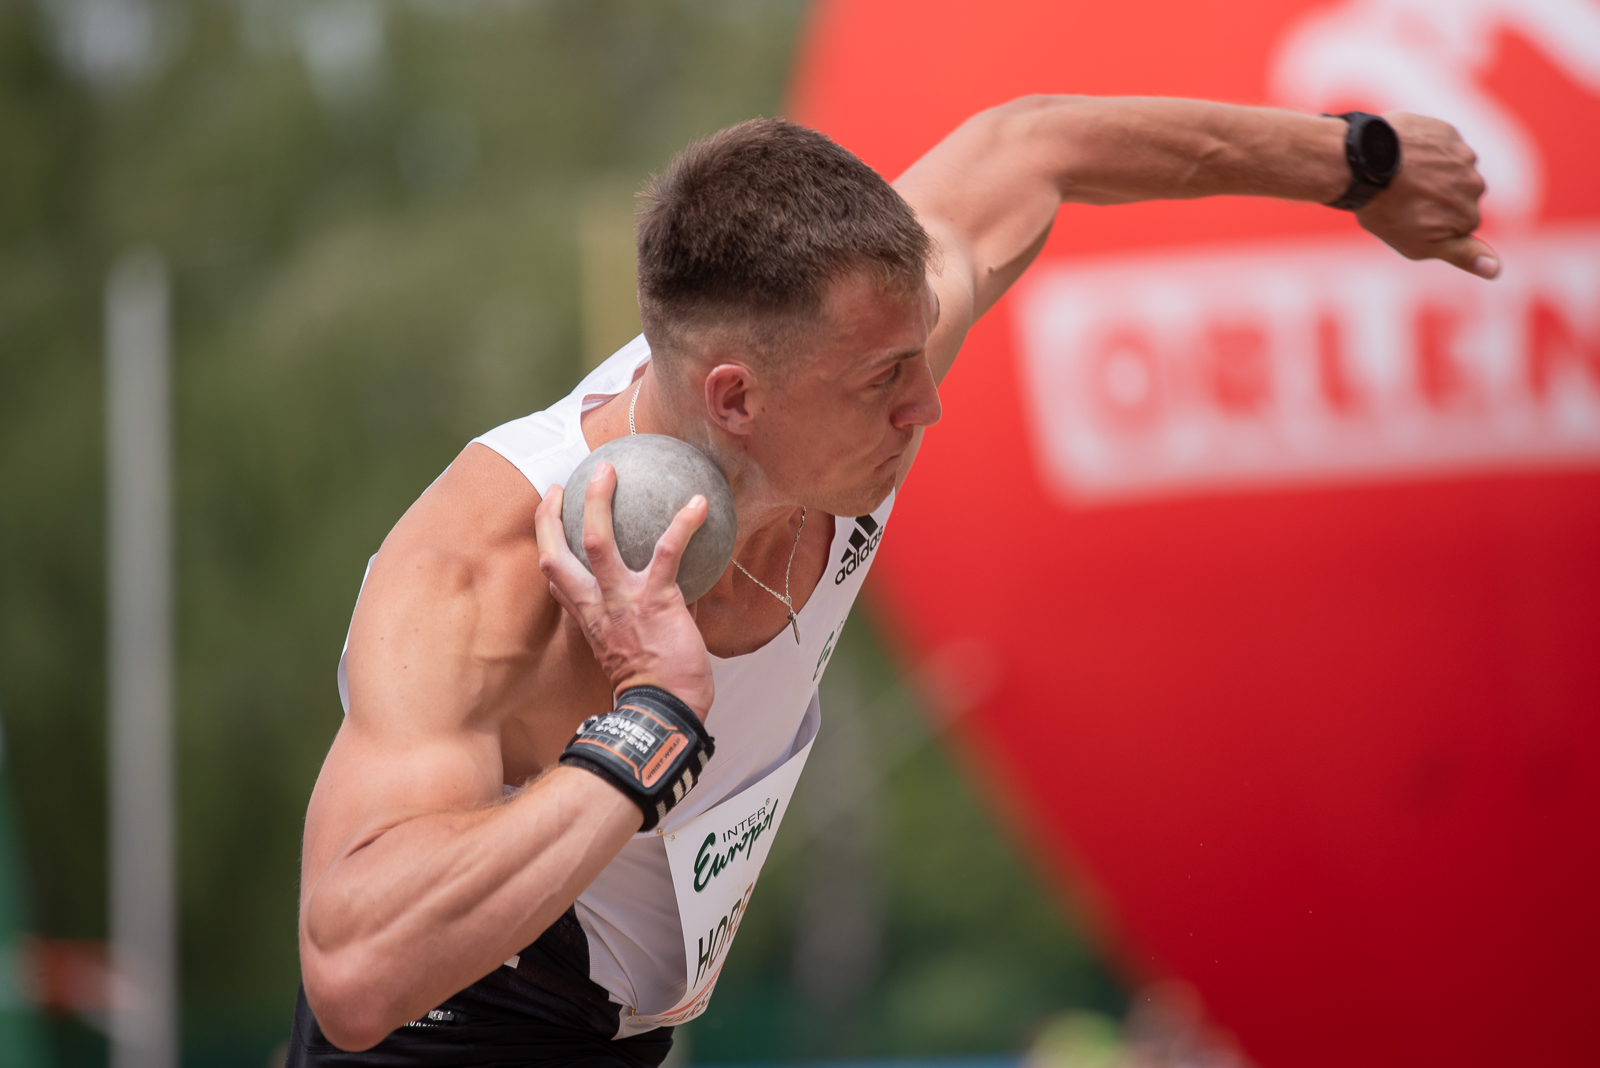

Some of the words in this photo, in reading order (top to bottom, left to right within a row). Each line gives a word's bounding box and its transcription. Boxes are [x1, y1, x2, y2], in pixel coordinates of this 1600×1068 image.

[835, 525, 883, 585] adidas
[601, 716, 656, 748] POWER
[663, 737, 681, 759] WRAP
[723, 806, 766, 843] INTER
